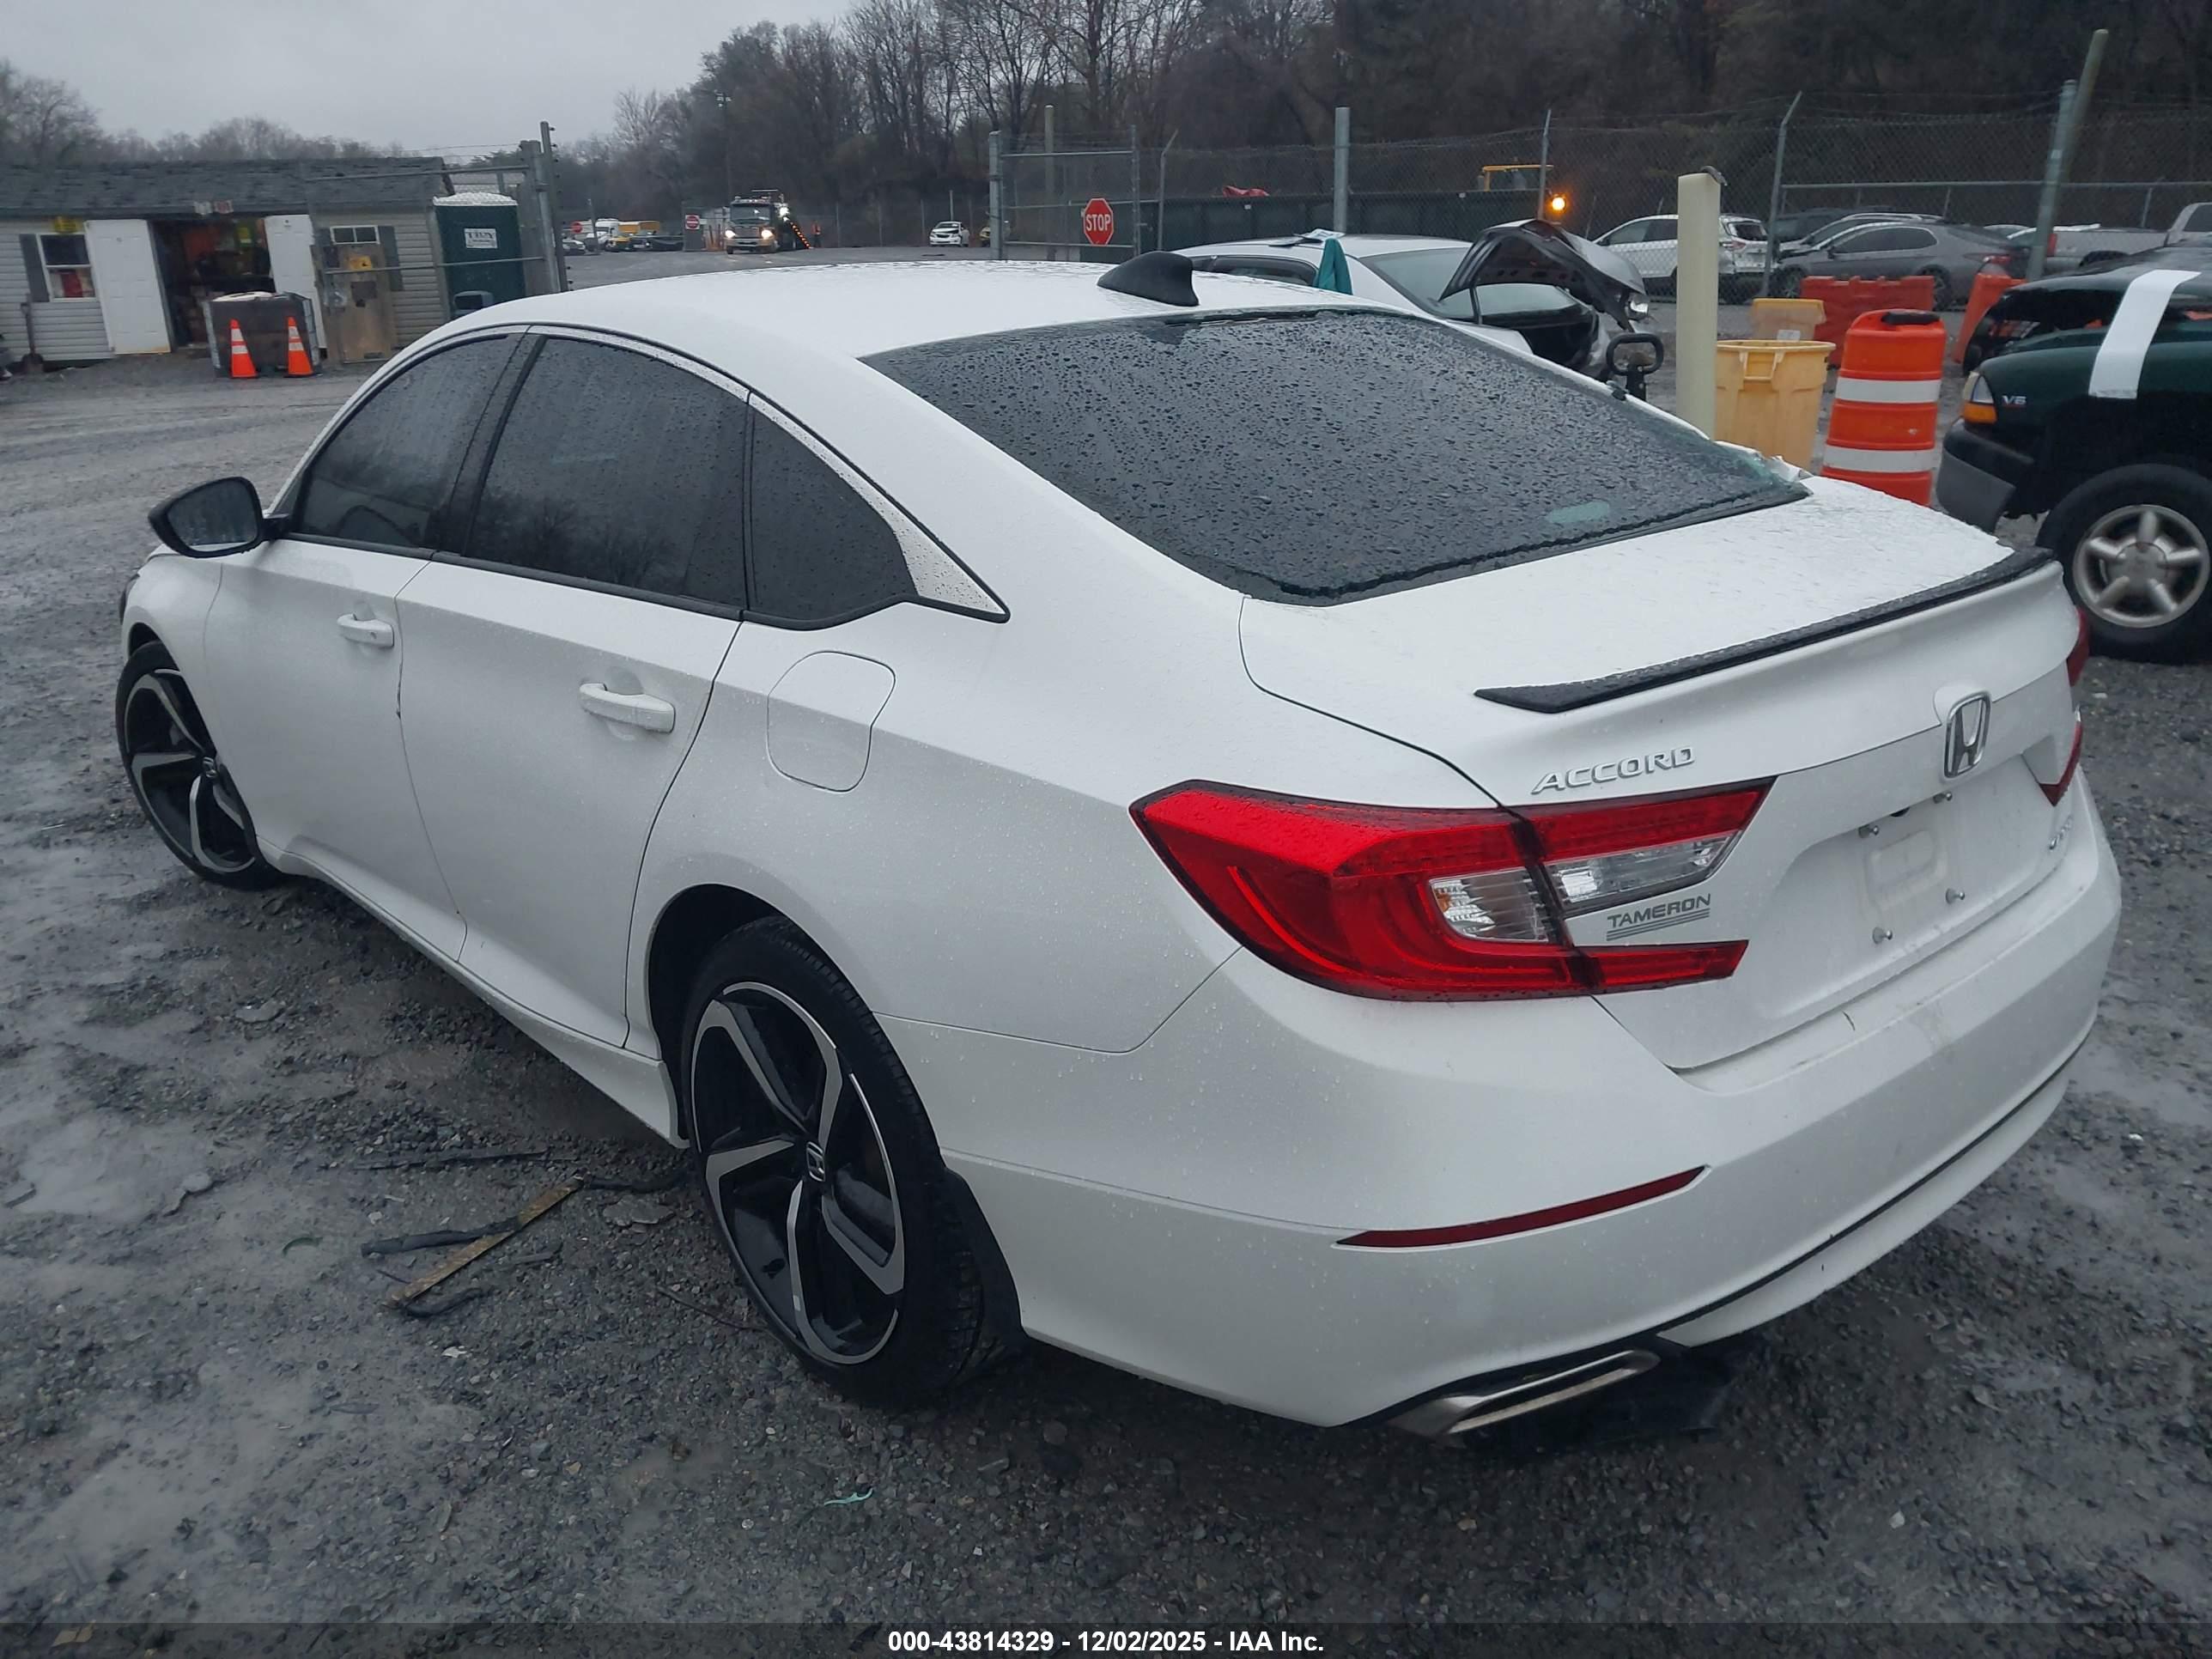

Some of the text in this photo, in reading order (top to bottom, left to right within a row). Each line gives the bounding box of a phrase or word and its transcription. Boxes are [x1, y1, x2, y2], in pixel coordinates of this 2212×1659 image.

[1085, 214, 1111, 232] STOP
[1531, 746, 1695, 795] ACCORD
[1607, 893, 1711, 928] TAMERON
